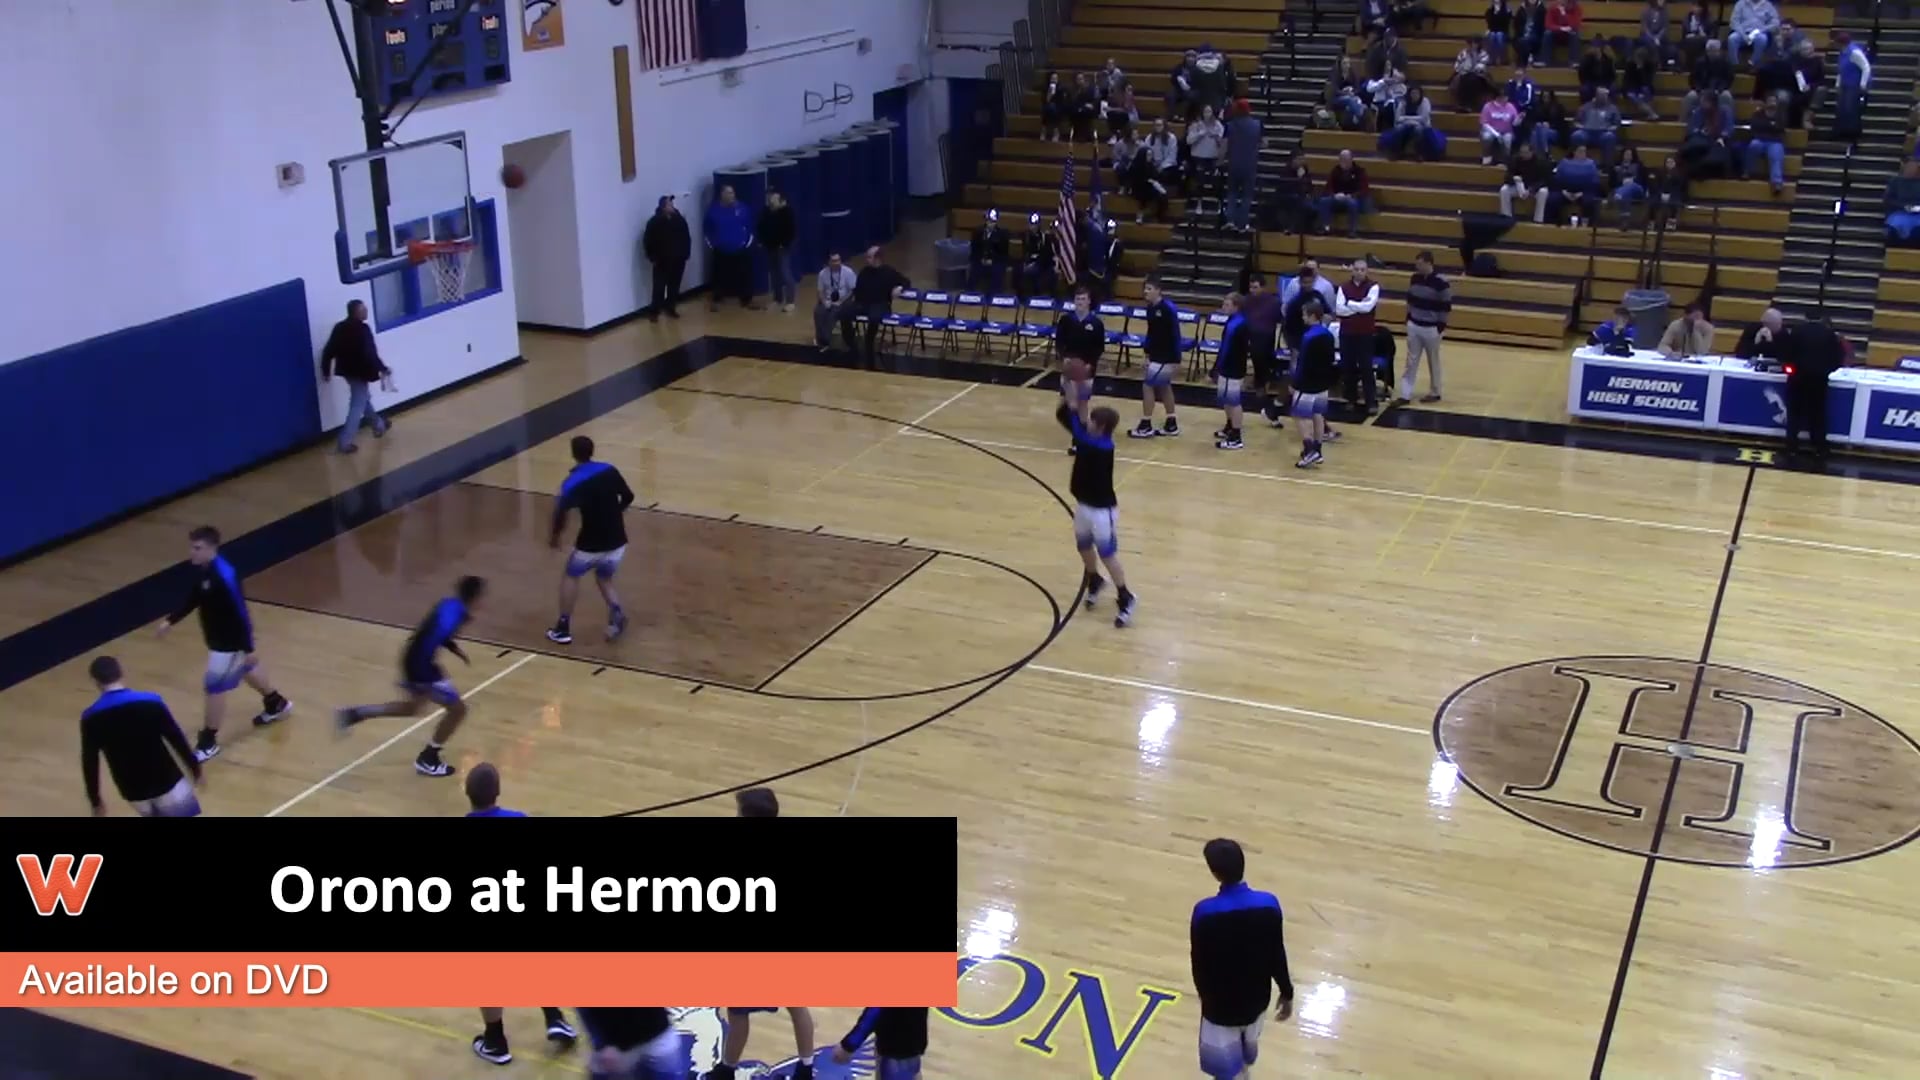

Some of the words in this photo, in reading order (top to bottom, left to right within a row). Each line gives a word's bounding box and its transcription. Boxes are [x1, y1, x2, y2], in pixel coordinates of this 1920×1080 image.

[1607, 375, 1684, 394] HERMON
[1586, 390, 1630, 405] HIGH
[1633, 395, 1700, 412] SCHOOL
[1735, 447, 1777, 464] H
[1500, 662, 1845, 852] H
